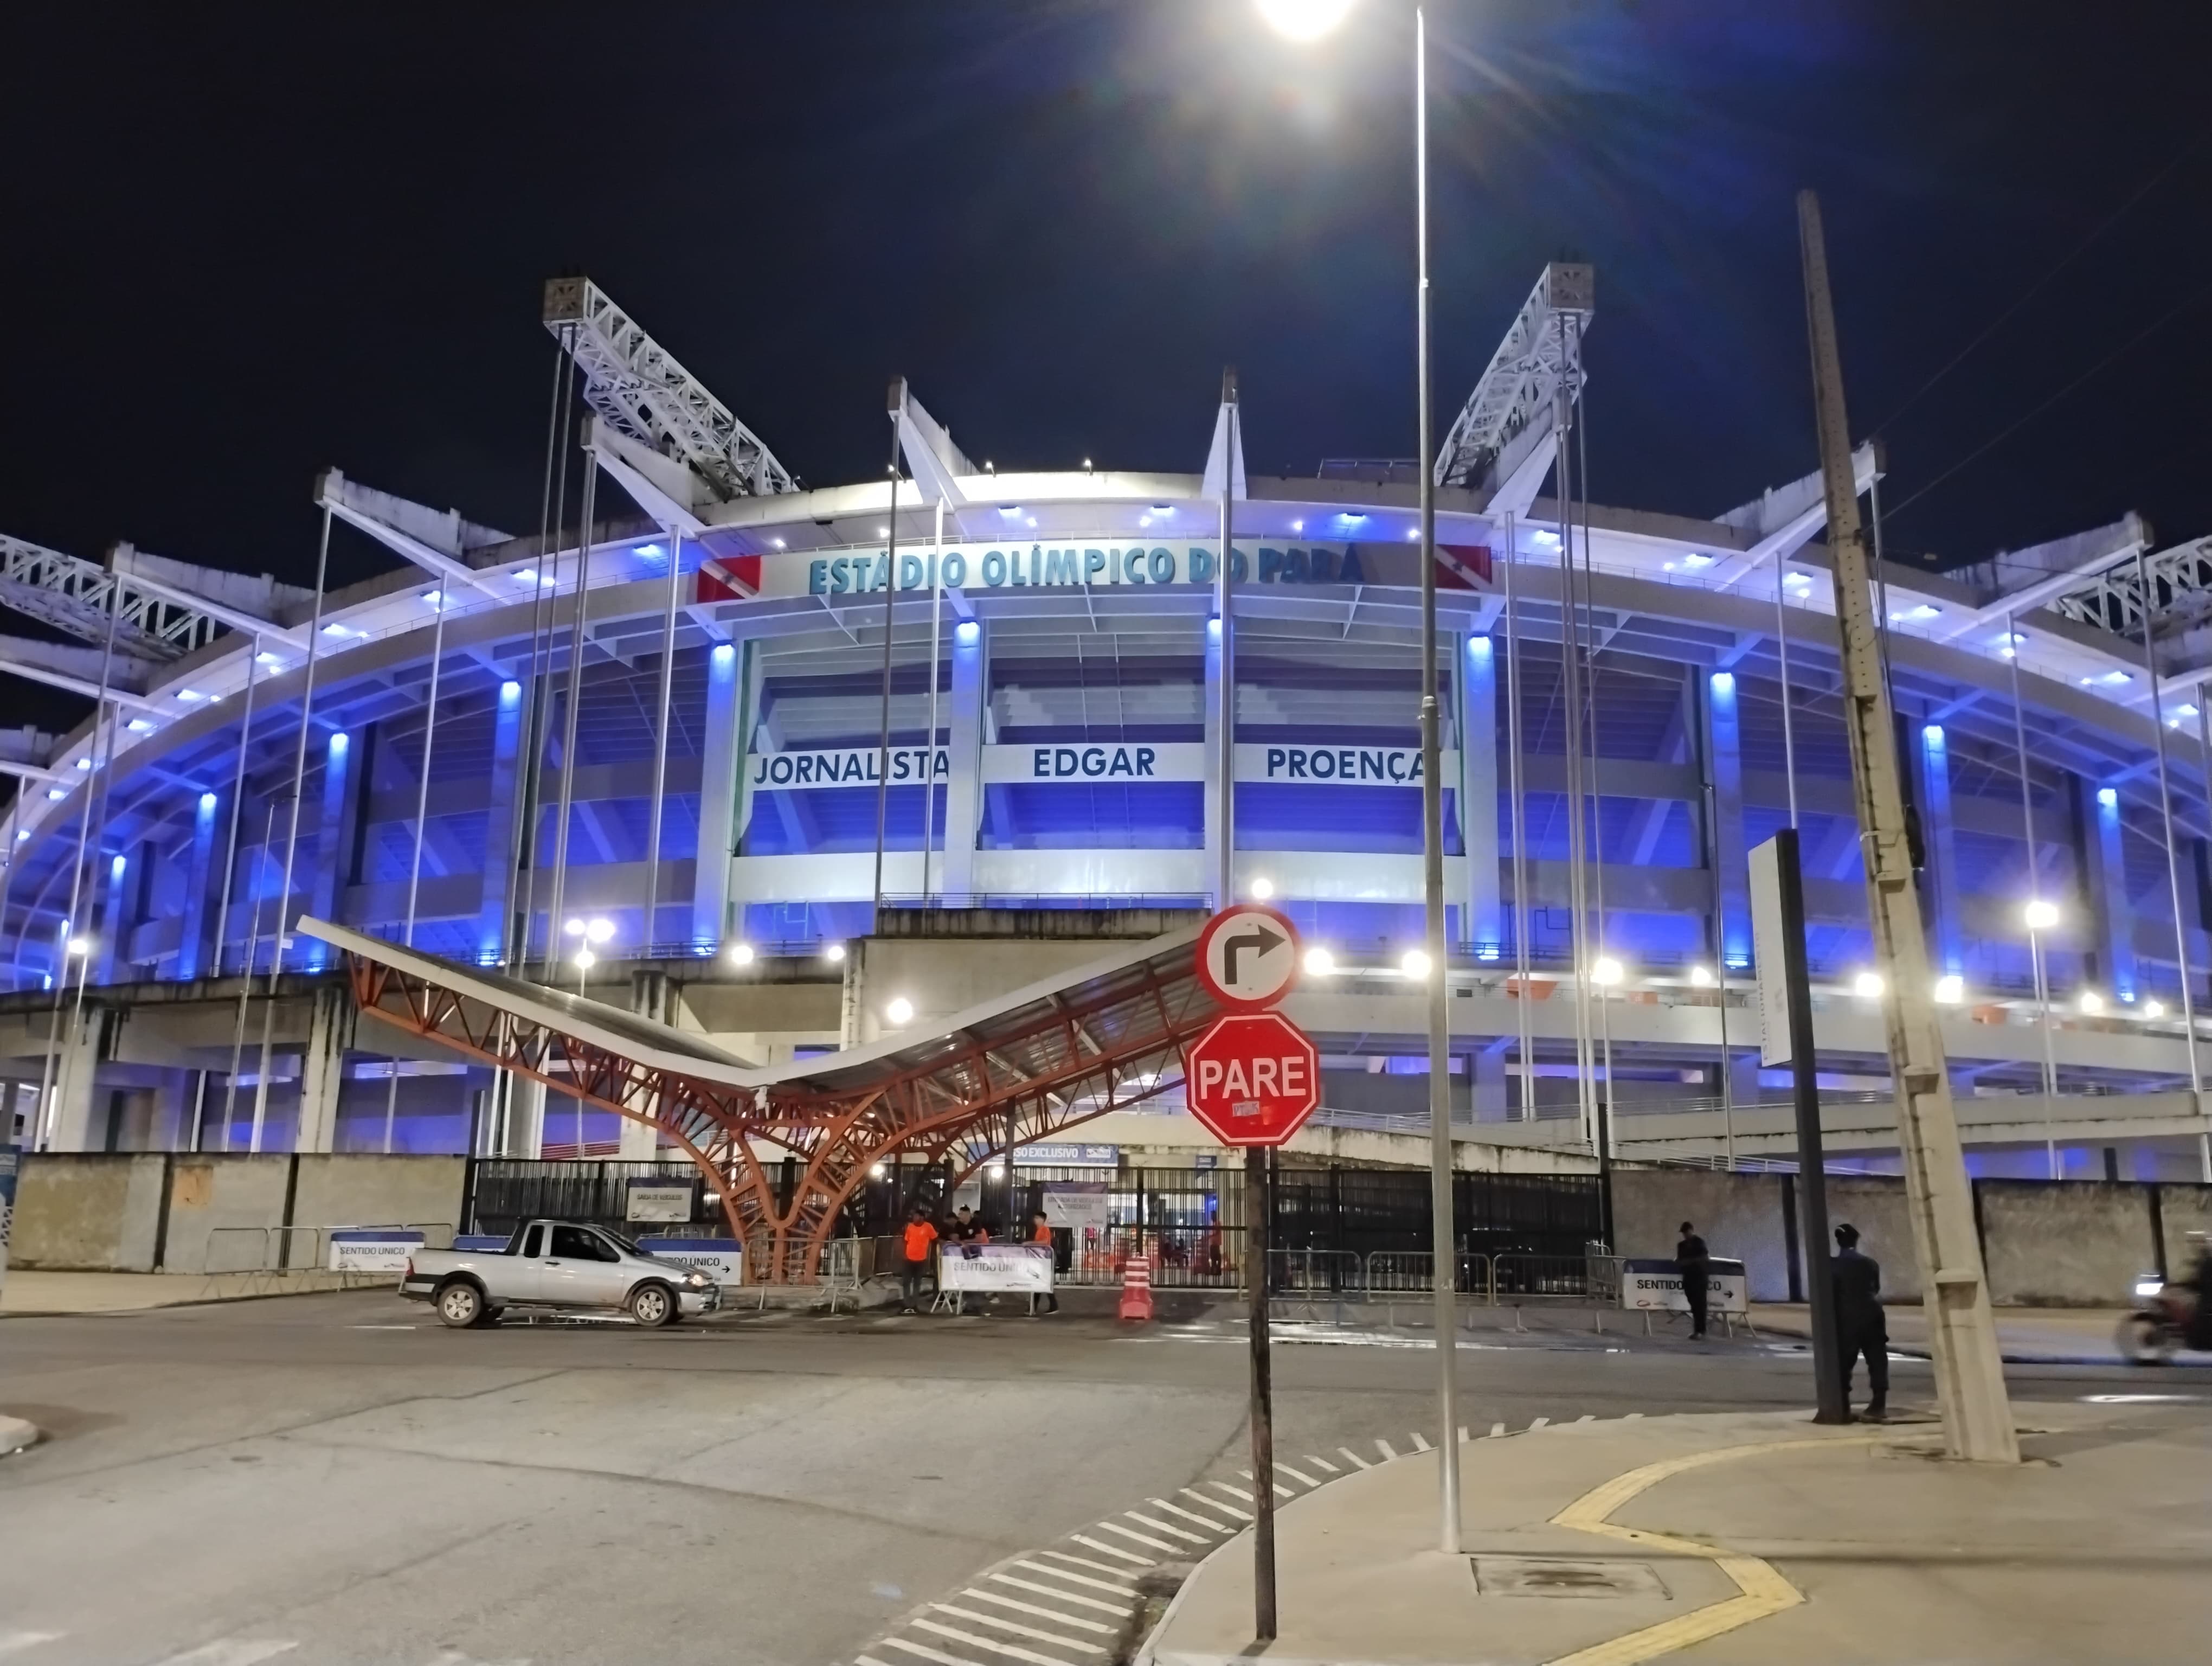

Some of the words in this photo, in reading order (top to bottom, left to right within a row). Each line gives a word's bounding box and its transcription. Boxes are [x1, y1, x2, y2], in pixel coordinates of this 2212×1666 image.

[810, 550, 966, 594] ESTÁDIO
[982, 543, 1175, 586] OLÍMPICO
[1189, 548, 1248, 584] DO
[754, 751, 949, 784] JORNALISTA
[1034, 748, 1155, 777] EDGAR
[1267, 748, 1424, 784] PROENÇA
[1200, 1056, 1306, 1099] PARE
[1029, 1148, 1078, 1158] EXCLUSIVO
[954, 1262, 995, 1272] SENTIDO
[1637, 1279, 1683, 1290] SENTIDO
